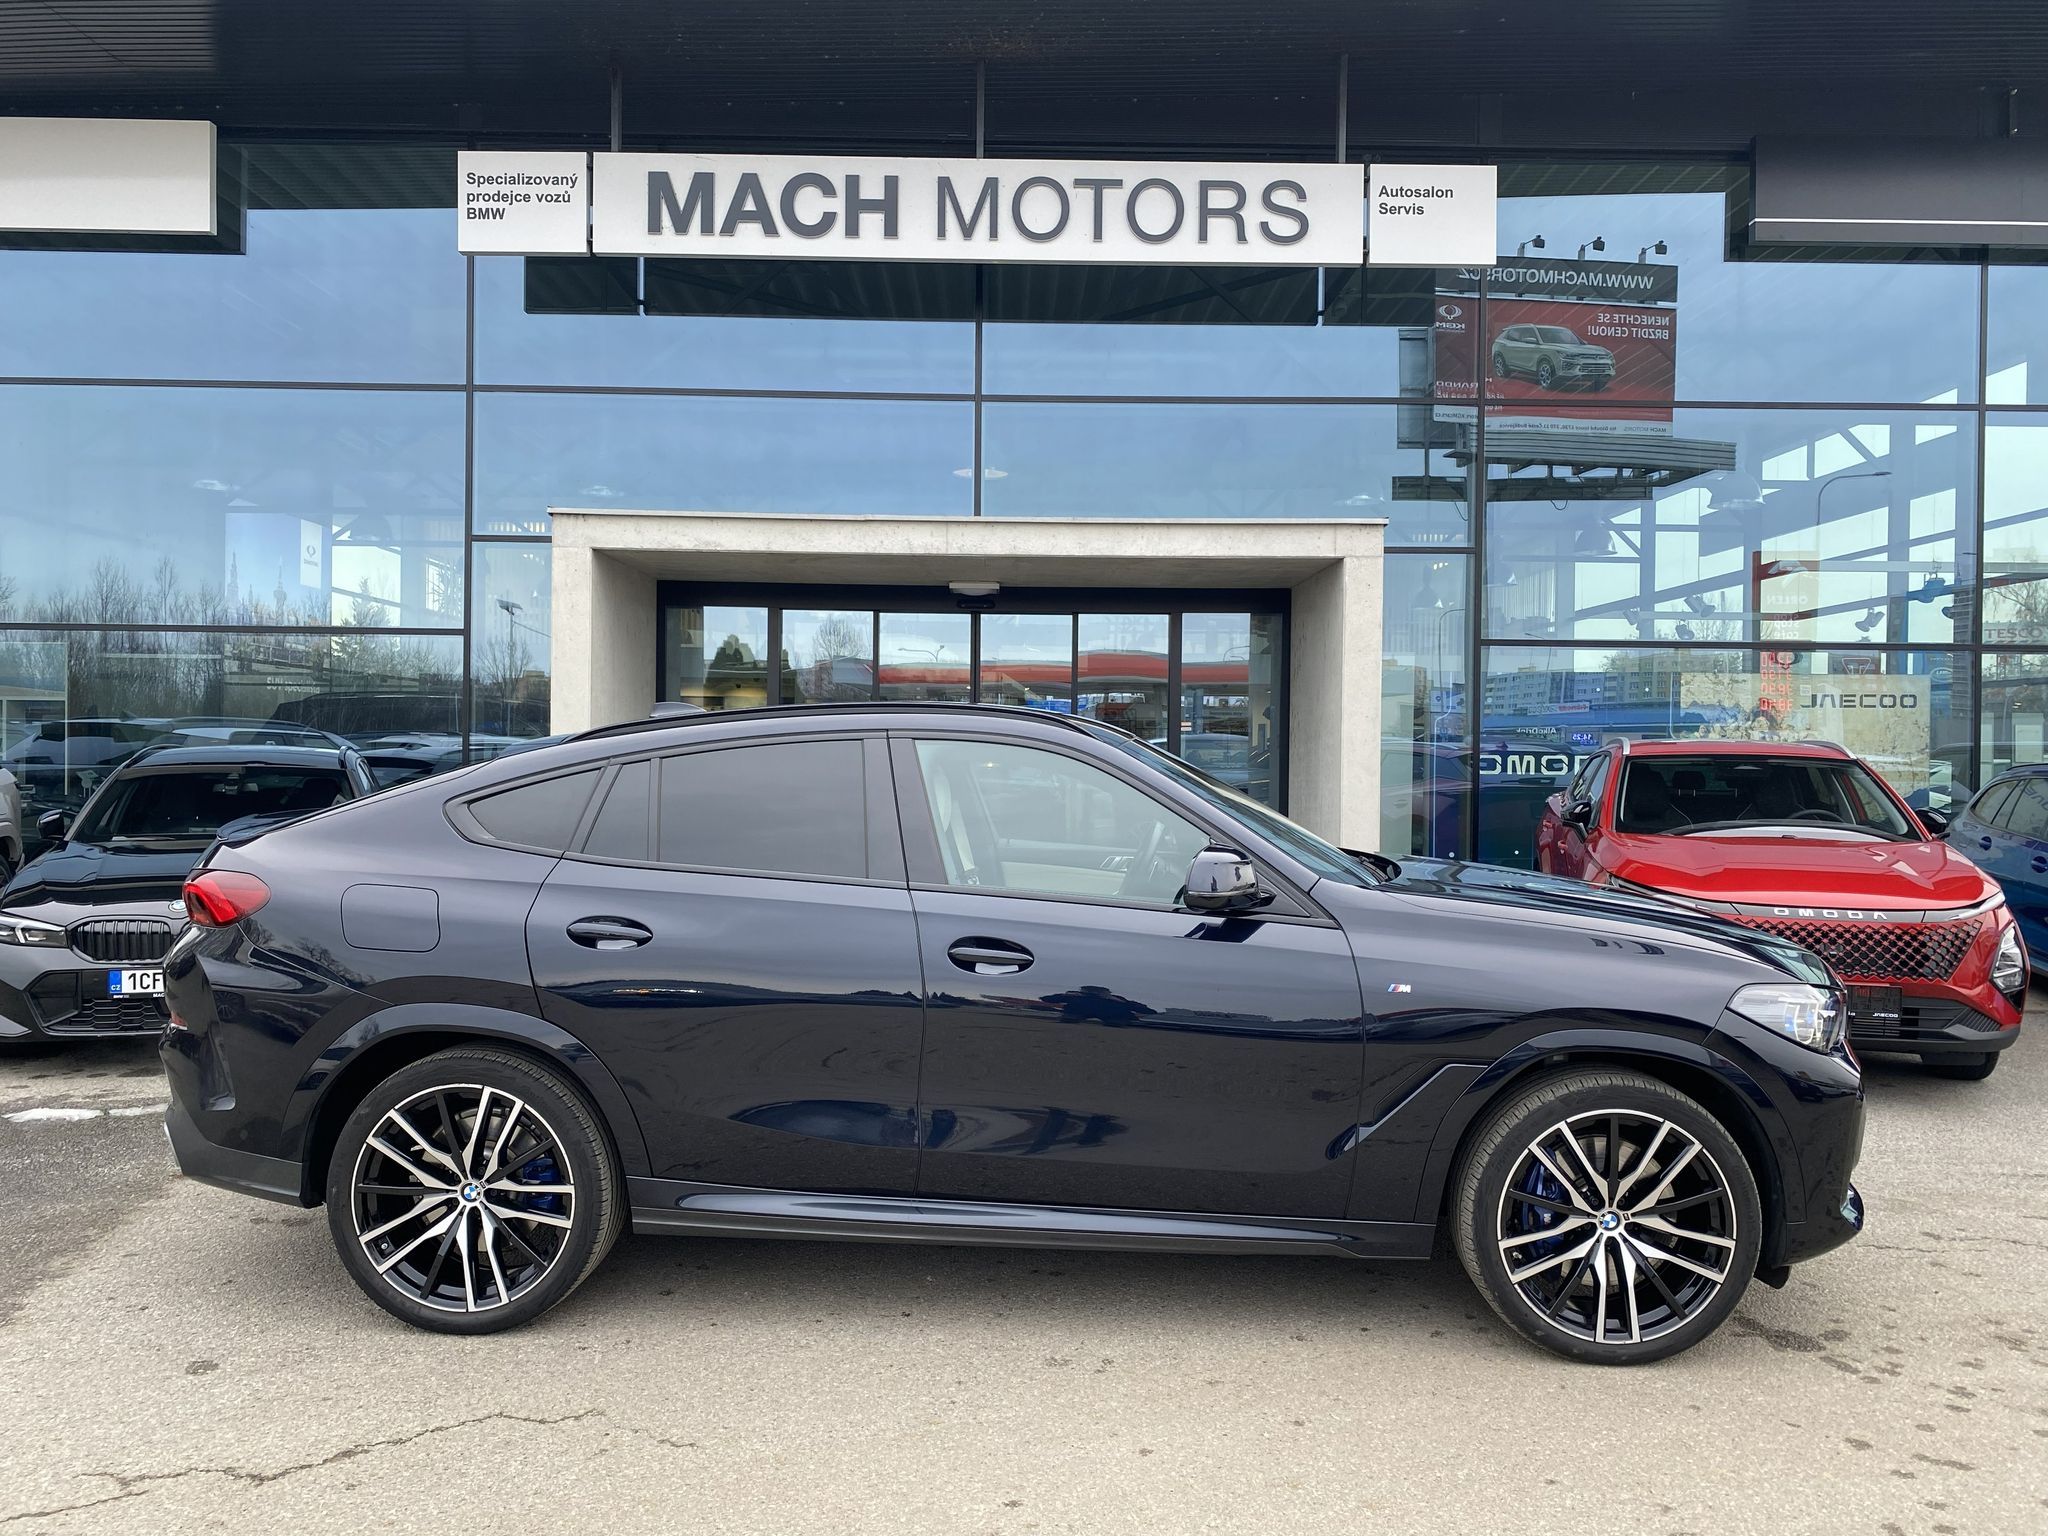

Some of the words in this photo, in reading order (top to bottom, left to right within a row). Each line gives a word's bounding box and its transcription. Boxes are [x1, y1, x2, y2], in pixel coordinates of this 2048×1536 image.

[466, 172, 578, 189] Specializovaný
[466, 190, 531, 205] prodejce
[535, 190, 571, 203] vozů
[1378, 185, 1454, 198] Autosalon
[466, 207, 506, 220] BMW
[647, 170, 899, 239] MACH
[936, 175, 1310, 246] MOTORS
[1378, 202, 1425, 215] Servis
[1984, 627, 2044, 639] TESCO
[1800, 693, 1918, 708] JAECOO
[1773, 907, 1888, 920] OMODA
[128, 972, 163, 990] 1CF
